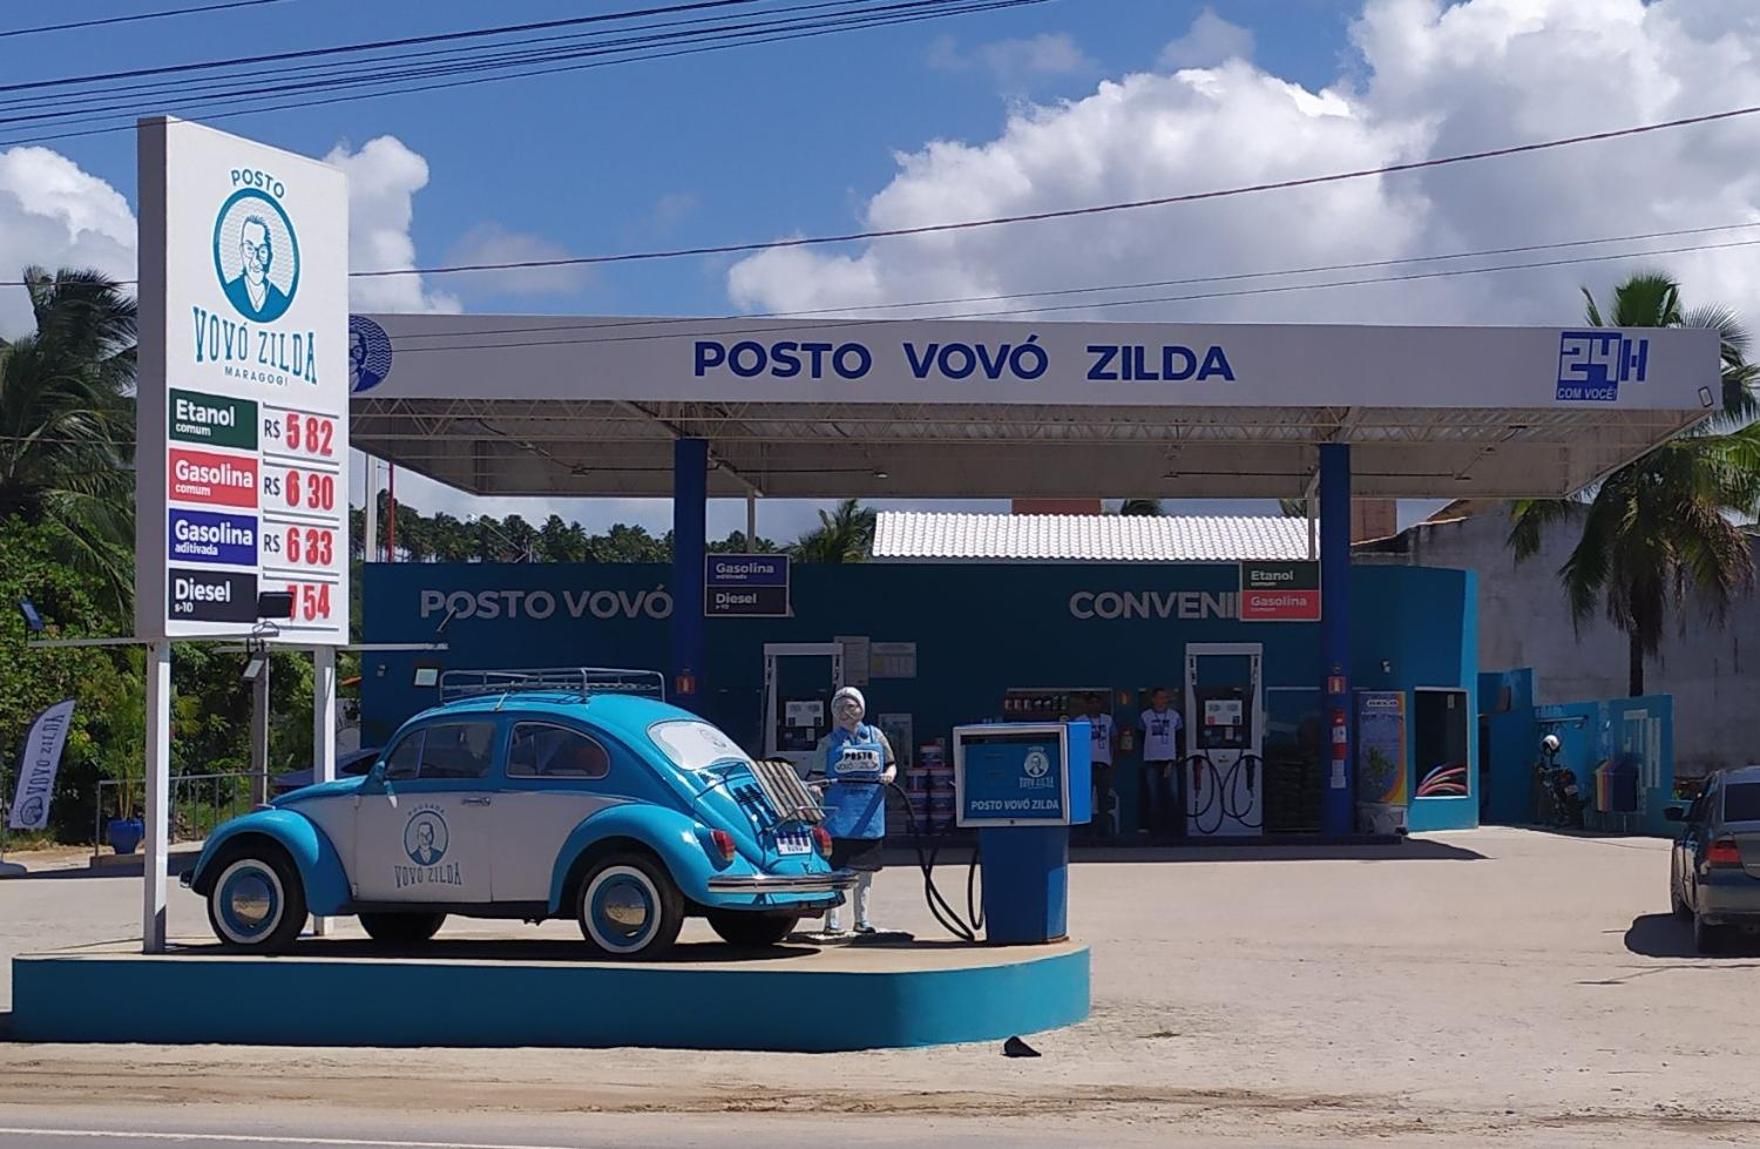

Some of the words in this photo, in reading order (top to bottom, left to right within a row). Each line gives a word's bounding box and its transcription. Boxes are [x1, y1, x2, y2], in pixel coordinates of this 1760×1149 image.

[231, 168, 285, 199] POSTO
[194, 307, 248, 361] VOVÓ
[259, 332, 318, 385] ZILDA
[694, 342, 873, 380] POSTO
[903, 335, 1049, 380] VOVÓ
[1086, 345, 1235, 381] ZILDA
[1560, 338, 1649, 382] 24H
[225, 366, 288, 386] MARAGOGI
[1557, 387, 1582, 399] COM
[176, 398, 235, 428] Etanol
[175, 422, 212, 437] comum
[175, 459, 254, 489] Gasolina
[175, 483, 211, 497] comum
[175, 519, 253, 546] Gasolina
[174, 541, 219, 556] aditivada
[715, 562, 775, 574] Gasolina
[1250, 570, 1294, 581] Etanol
[175, 577, 231, 603] Diesel
[715, 592, 758, 604] Diesel
[174, 601, 194, 614] s-10
[421, 591, 554, 619] POSTO
[563, 585, 673, 619] VOVÓ
[1250, 595, 1308, 607] Gasolina
[844, 752, 873, 760] POSTO
[971, 800, 1002, 811] POSTO
[1004, 798, 1031, 810] VOVÓ
[1031, 799, 1059, 810] ZILDA
[428, 862, 462, 886] ZILDA
